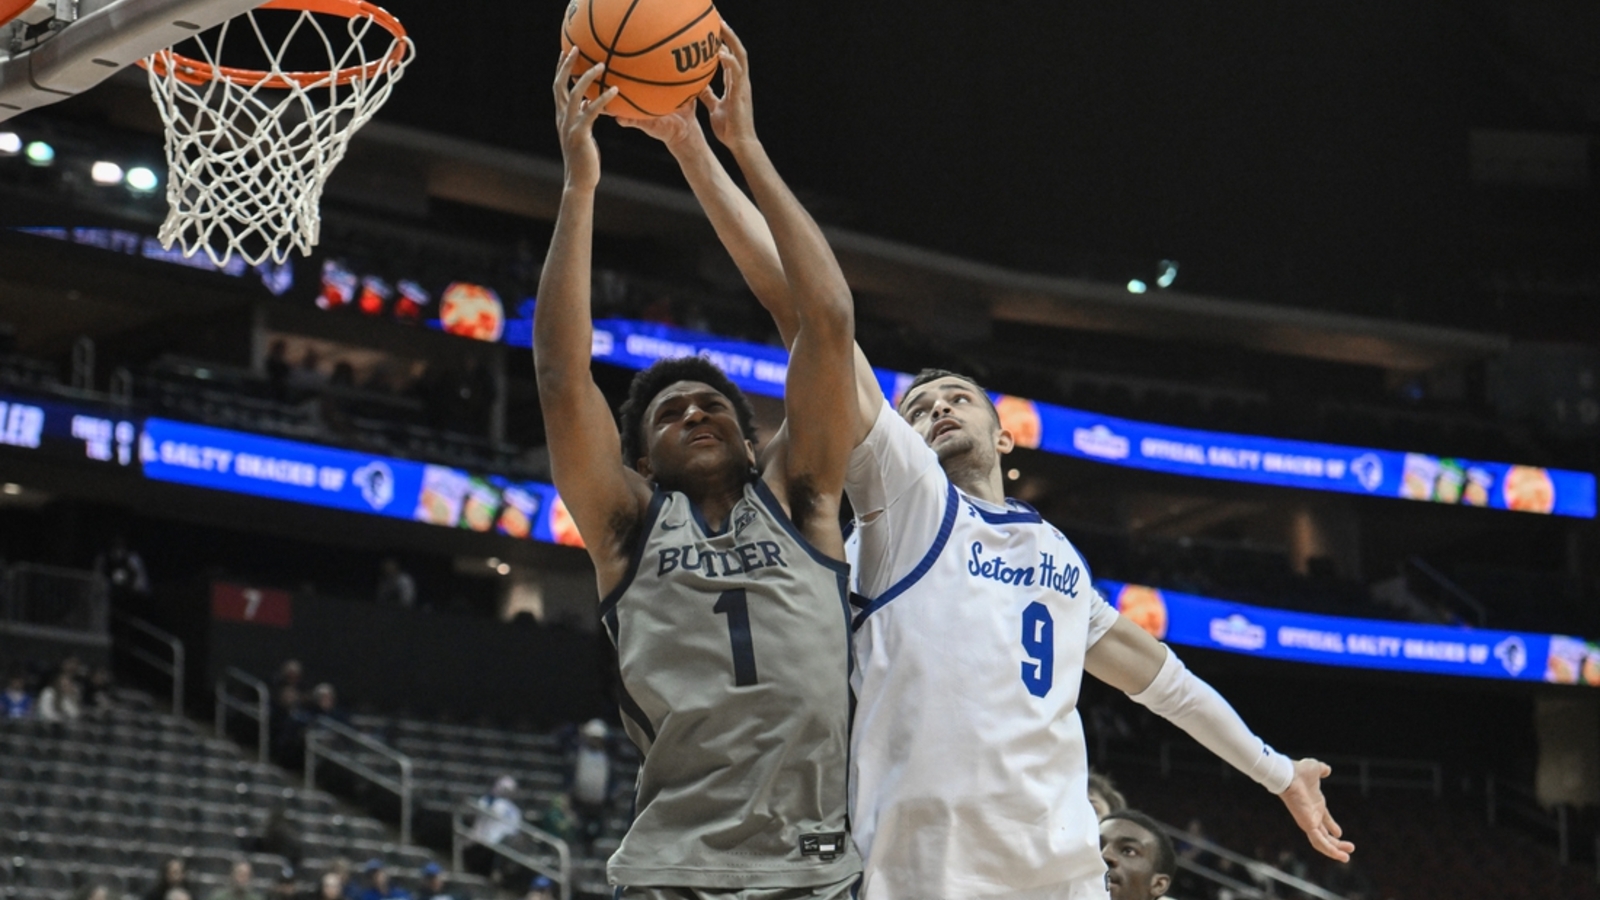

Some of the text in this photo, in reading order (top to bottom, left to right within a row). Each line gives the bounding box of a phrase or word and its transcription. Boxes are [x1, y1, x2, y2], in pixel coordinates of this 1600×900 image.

[671, 31, 721, 73] Wil
[657, 540, 787, 577] BUTLER
[968, 541, 1080, 599] Seton Hall
[242, 588, 262, 620] 7
[713, 587, 759, 687] 1
[1021, 600, 1054, 699] 9
